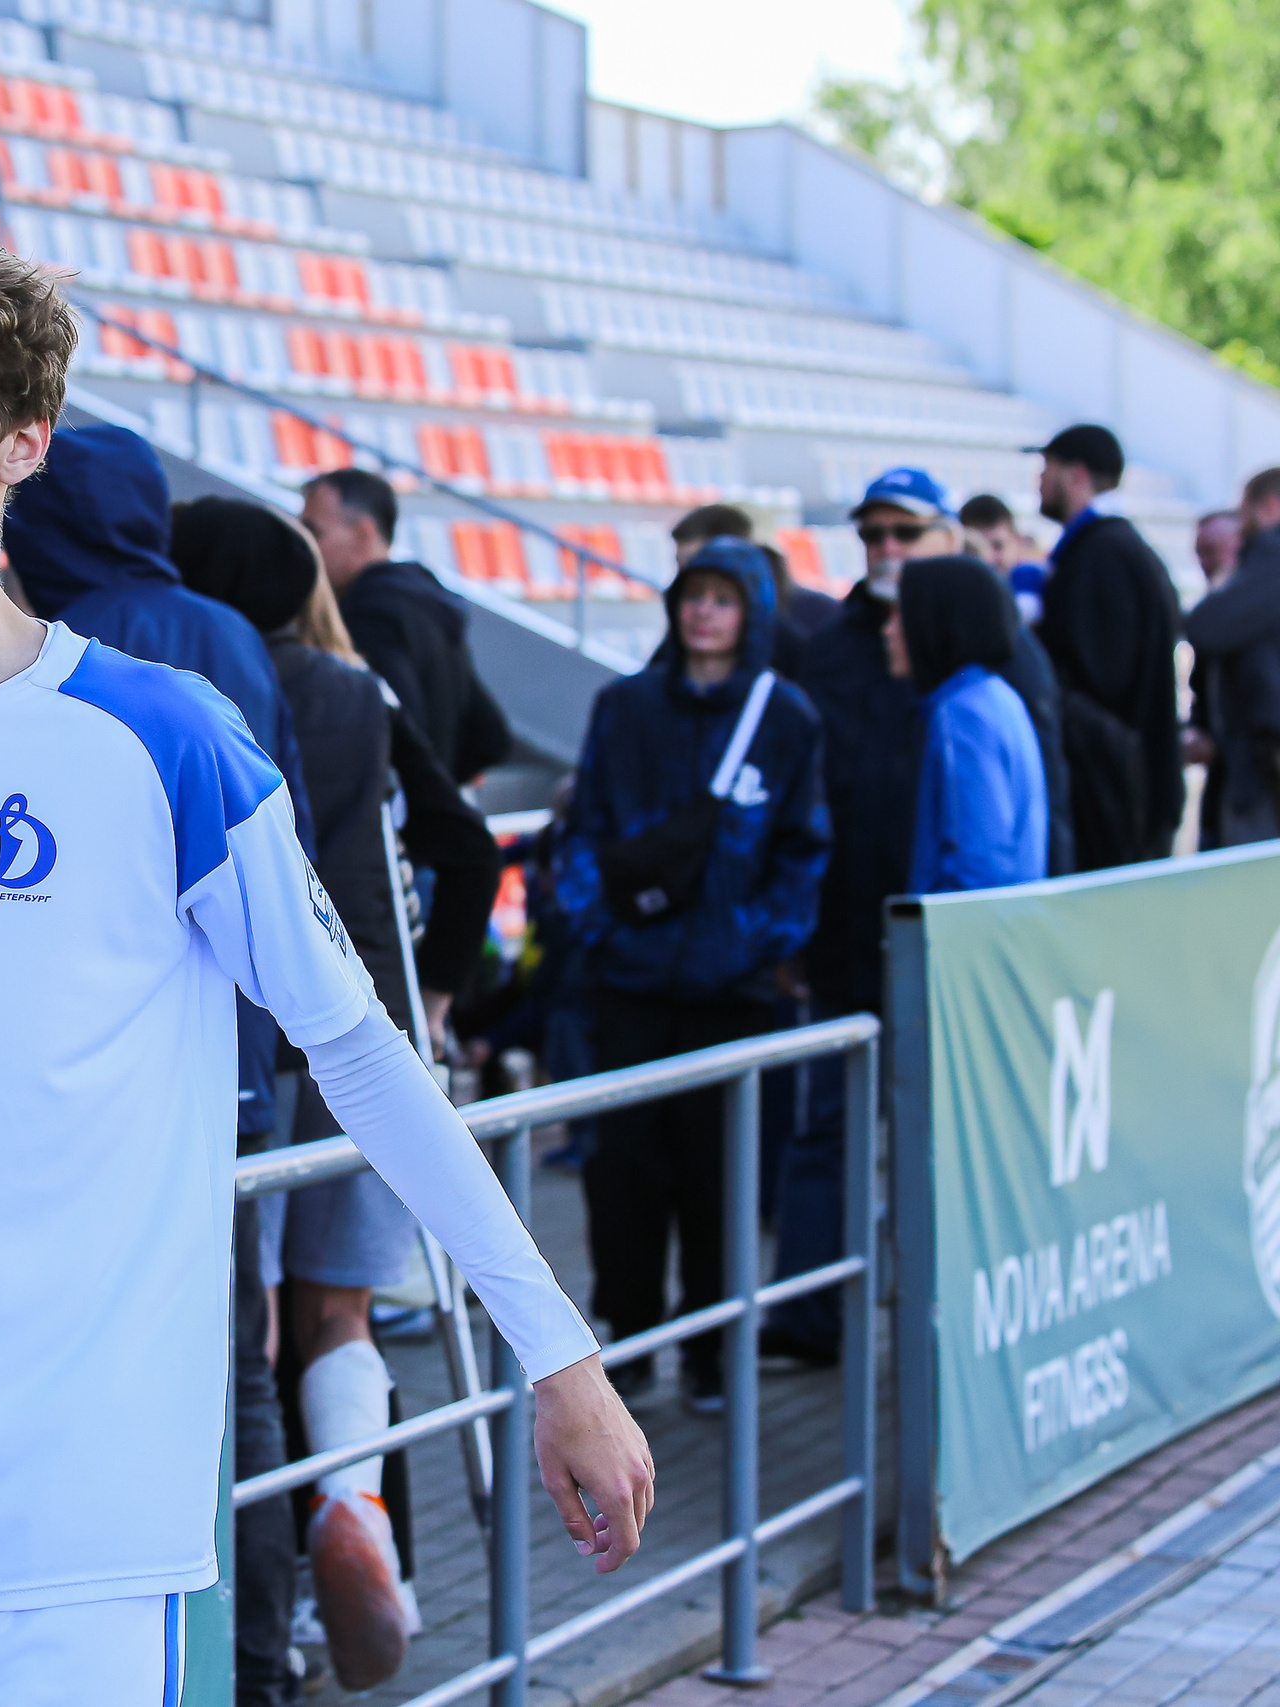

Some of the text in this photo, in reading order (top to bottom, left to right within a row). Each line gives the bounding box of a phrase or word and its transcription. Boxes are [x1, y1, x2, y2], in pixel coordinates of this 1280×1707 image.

[974, 1200, 1173, 1360] NOVA ARENA
[1024, 1326, 1129, 1453] FITNESS
